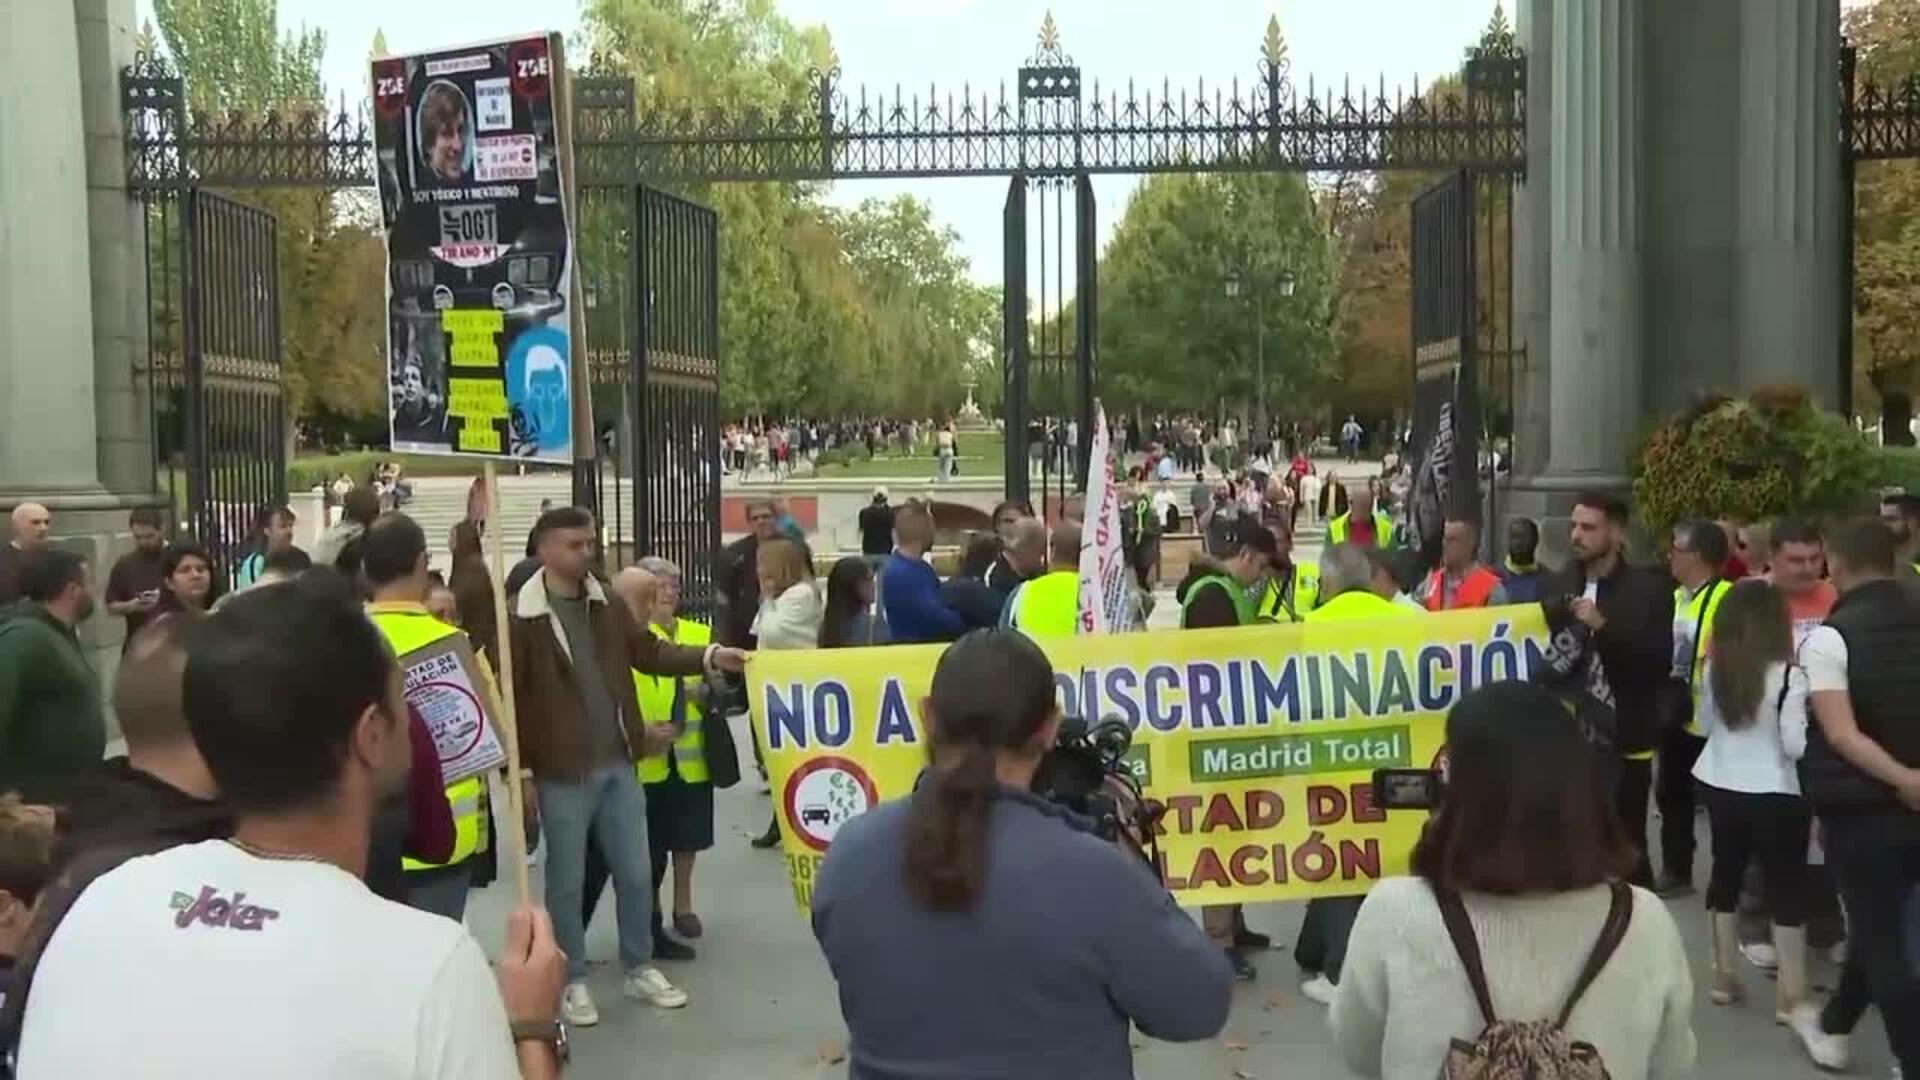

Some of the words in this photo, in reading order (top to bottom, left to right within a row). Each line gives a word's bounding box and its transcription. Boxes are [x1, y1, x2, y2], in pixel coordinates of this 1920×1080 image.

[412, 189, 430, 203] SOY
[464, 188, 470, 200] Y
[471, 184, 519, 199] MENTIROSO
[437, 654, 453, 667] DE
[766, 681, 851, 749] NO
[876, 679, 917, 744] A
[1203, 742, 1312, 774] Madrid
[1322, 734, 1400, 764] Total
[1307, 783, 1387, 826] DE
